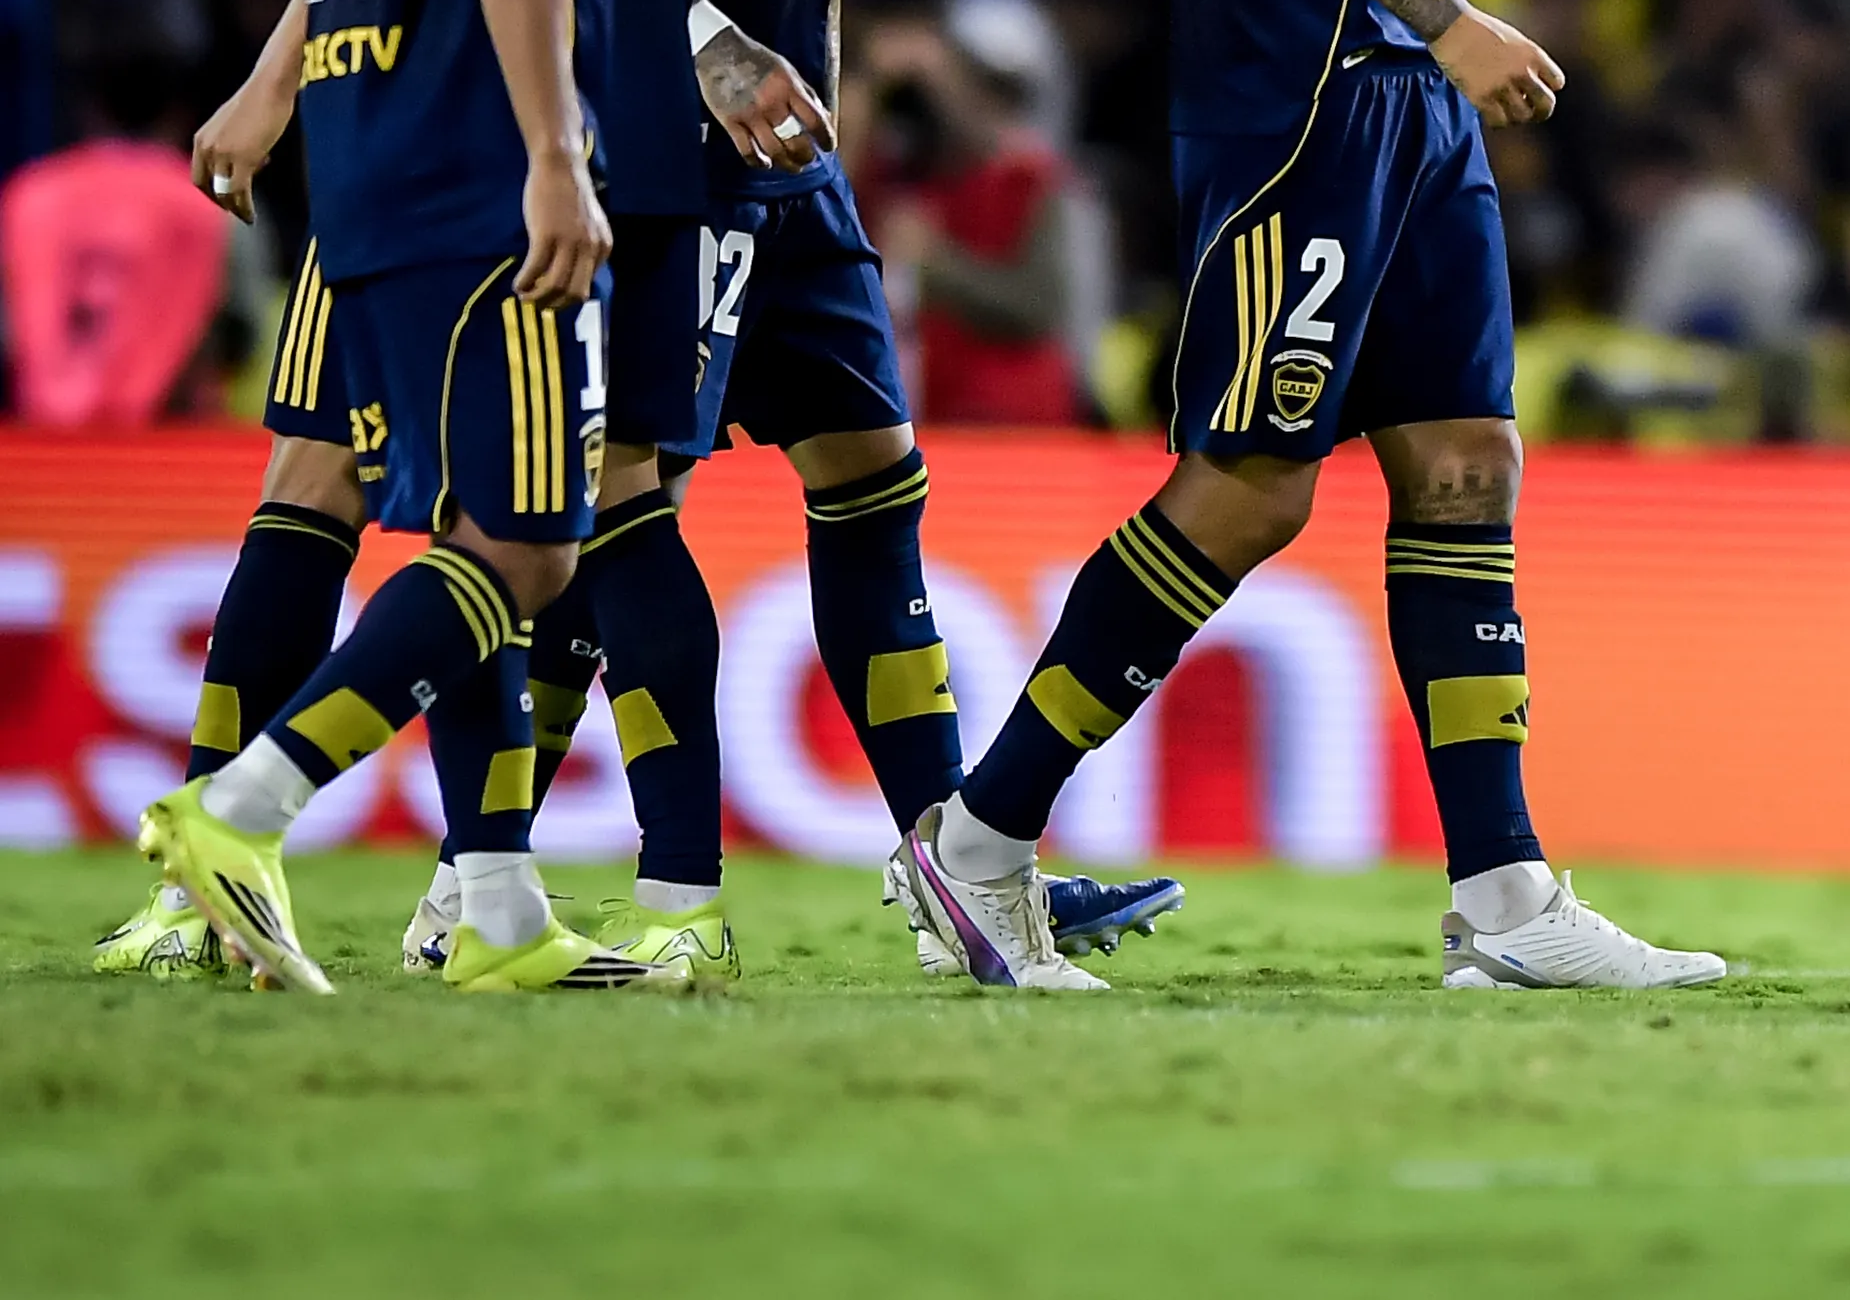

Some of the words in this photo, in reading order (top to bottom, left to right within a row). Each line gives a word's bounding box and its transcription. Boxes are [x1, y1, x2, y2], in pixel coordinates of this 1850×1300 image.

[1286, 238, 1345, 342] 2
[575, 301, 605, 412] 1
[1279, 380, 1314, 397] CABJ
[1474, 622, 1526, 645] CA
